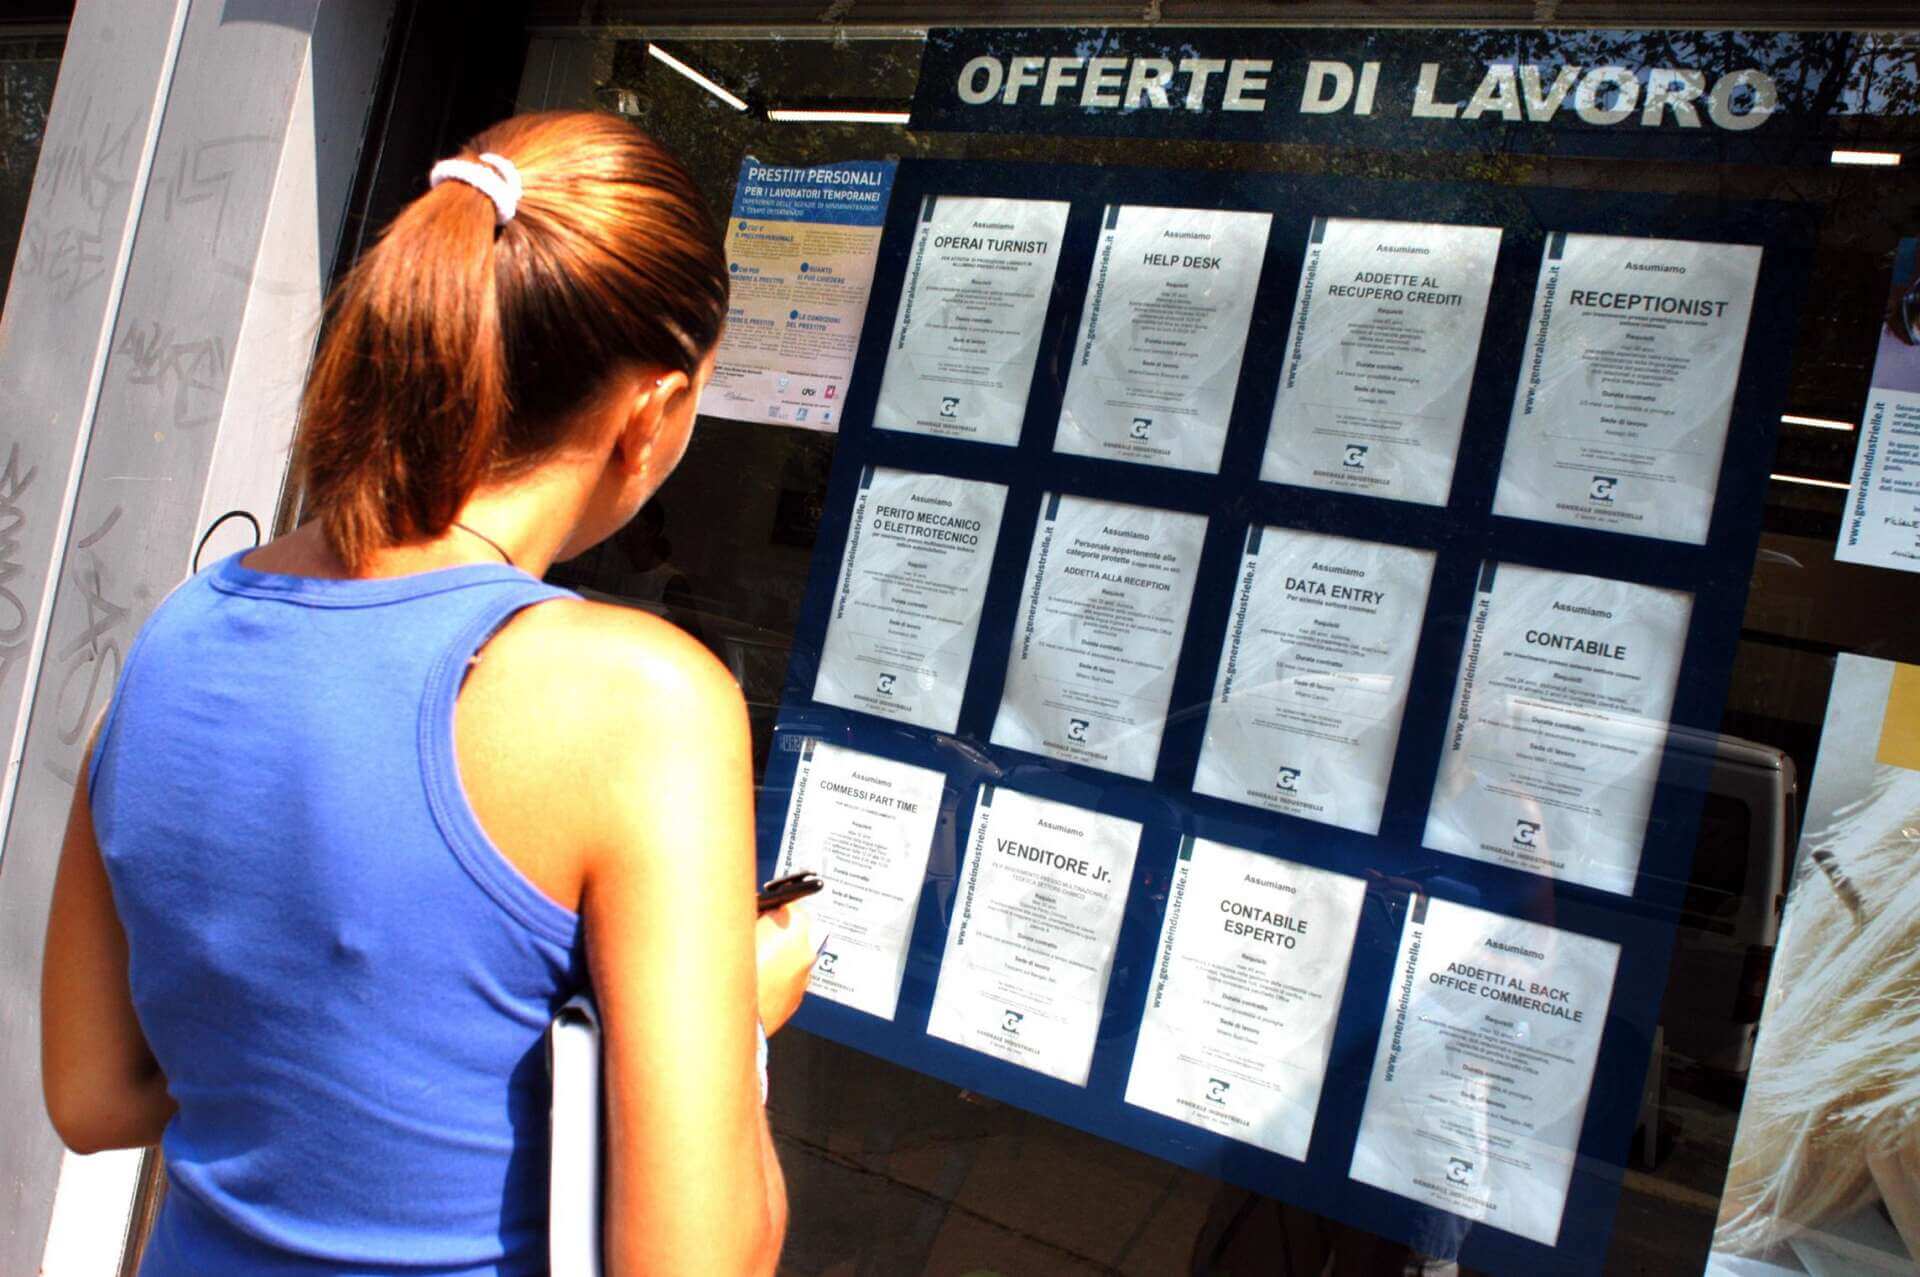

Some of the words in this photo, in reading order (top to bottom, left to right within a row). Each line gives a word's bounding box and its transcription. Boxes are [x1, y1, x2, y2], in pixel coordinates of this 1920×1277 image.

[957, 56, 1273, 112] OFFERTE
[1300, 61, 1380, 116] DI
[1410, 63, 1778, 130] LAVORO
[748, 167, 805, 182] PRESTITI
[808, 169, 882, 186] PERSONALI
[745, 186, 763, 197] PER
[770, 187, 821, 199] LAVORATORI
[823, 190, 880, 201] TEMPORANEI
[973, 220, 1015, 231] Assumiamo
[1164, 230, 1211, 240] Assumiamo
[934, 236, 983, 251] OPERAI
[988, 239, 1048, 255] TURNISTI
[1376, 244, 1430, 255] Assumiamo
[1144, 254, 1178, 267] HELP
[1183, 256, 1221, 269] DESK
[1625, 262, 1686, 274] Assumiamo
[1355, 272, 1418, 287] ADDETTE
[1421, 276, 1439, 289] AL
[1328, 285, 1403, 300] RECUPERO
[1407, 291, 1462, 306] CREDITI
[1570, 290, 1728, 317] RECEPTIONIST
[1524, 266, 1560, 415] www.generaleindustrielle.it
[1848, 402, 1885, 546] www.generaleindustrielle.it
[911, 494, 952, 507] Assumiamo
[877, 506, 914, 521] PERITO
[917, 512, 981, 532] MECCANICO
[874, 520, 882, 530] O
[884, 521, 978, 545] ELETTROTECNICO
[1102, 526, 1150, 541] Assumiamo
[1074, 539, 1110, 553] Personale
[1064, 567, 1100, 580] ADDETTA
[1102, 573, 1122, 583] ALLA
[1124, 576, 1170, 591] RECEPTION
[1312, 562, 1365, 578] Assumiamo
[1285, 577, 1326, 596] DATA
[1331, 585, 1384, 604] ENTRY
[1552, 601, 1612, 619] Assumiamo
[1526, 630, 1626, 660] CONTABILE
[1453, 599, 1489, 751] www.generaleindustrielle.it
[851, 771, 892, 787] Assumiamo
[820, 781, 868, 801] COMMESSI
[870, 793, 894, 807] PART
[896, 800, 917, 813] TIME
[1038, 819, 1084, 837] Assumiamo
[997, 839, 1089, 876] VENDITORE
[1091, 866, 1112, 883] Jr.
[1244, 874, 1297, 895] Assumiamo
[1221, 900, 1307, 934] CONTABILE
[1154, 867, 1188, 1008] www.generaleindustrielle.it
[1224, 920, 1296, 950] ESPERTO
[1484, 938, 1544, 960] Assumiamo
[1447, 961, 1505, 985] ADDETTI
[1508, 977, 1526, 992] AL
[1529, 983, 1570, 1003] BACK
[1429, 972, 1476, 993] OFFICE
[1480, 984, 1583, 1023] COMMERCIALE
